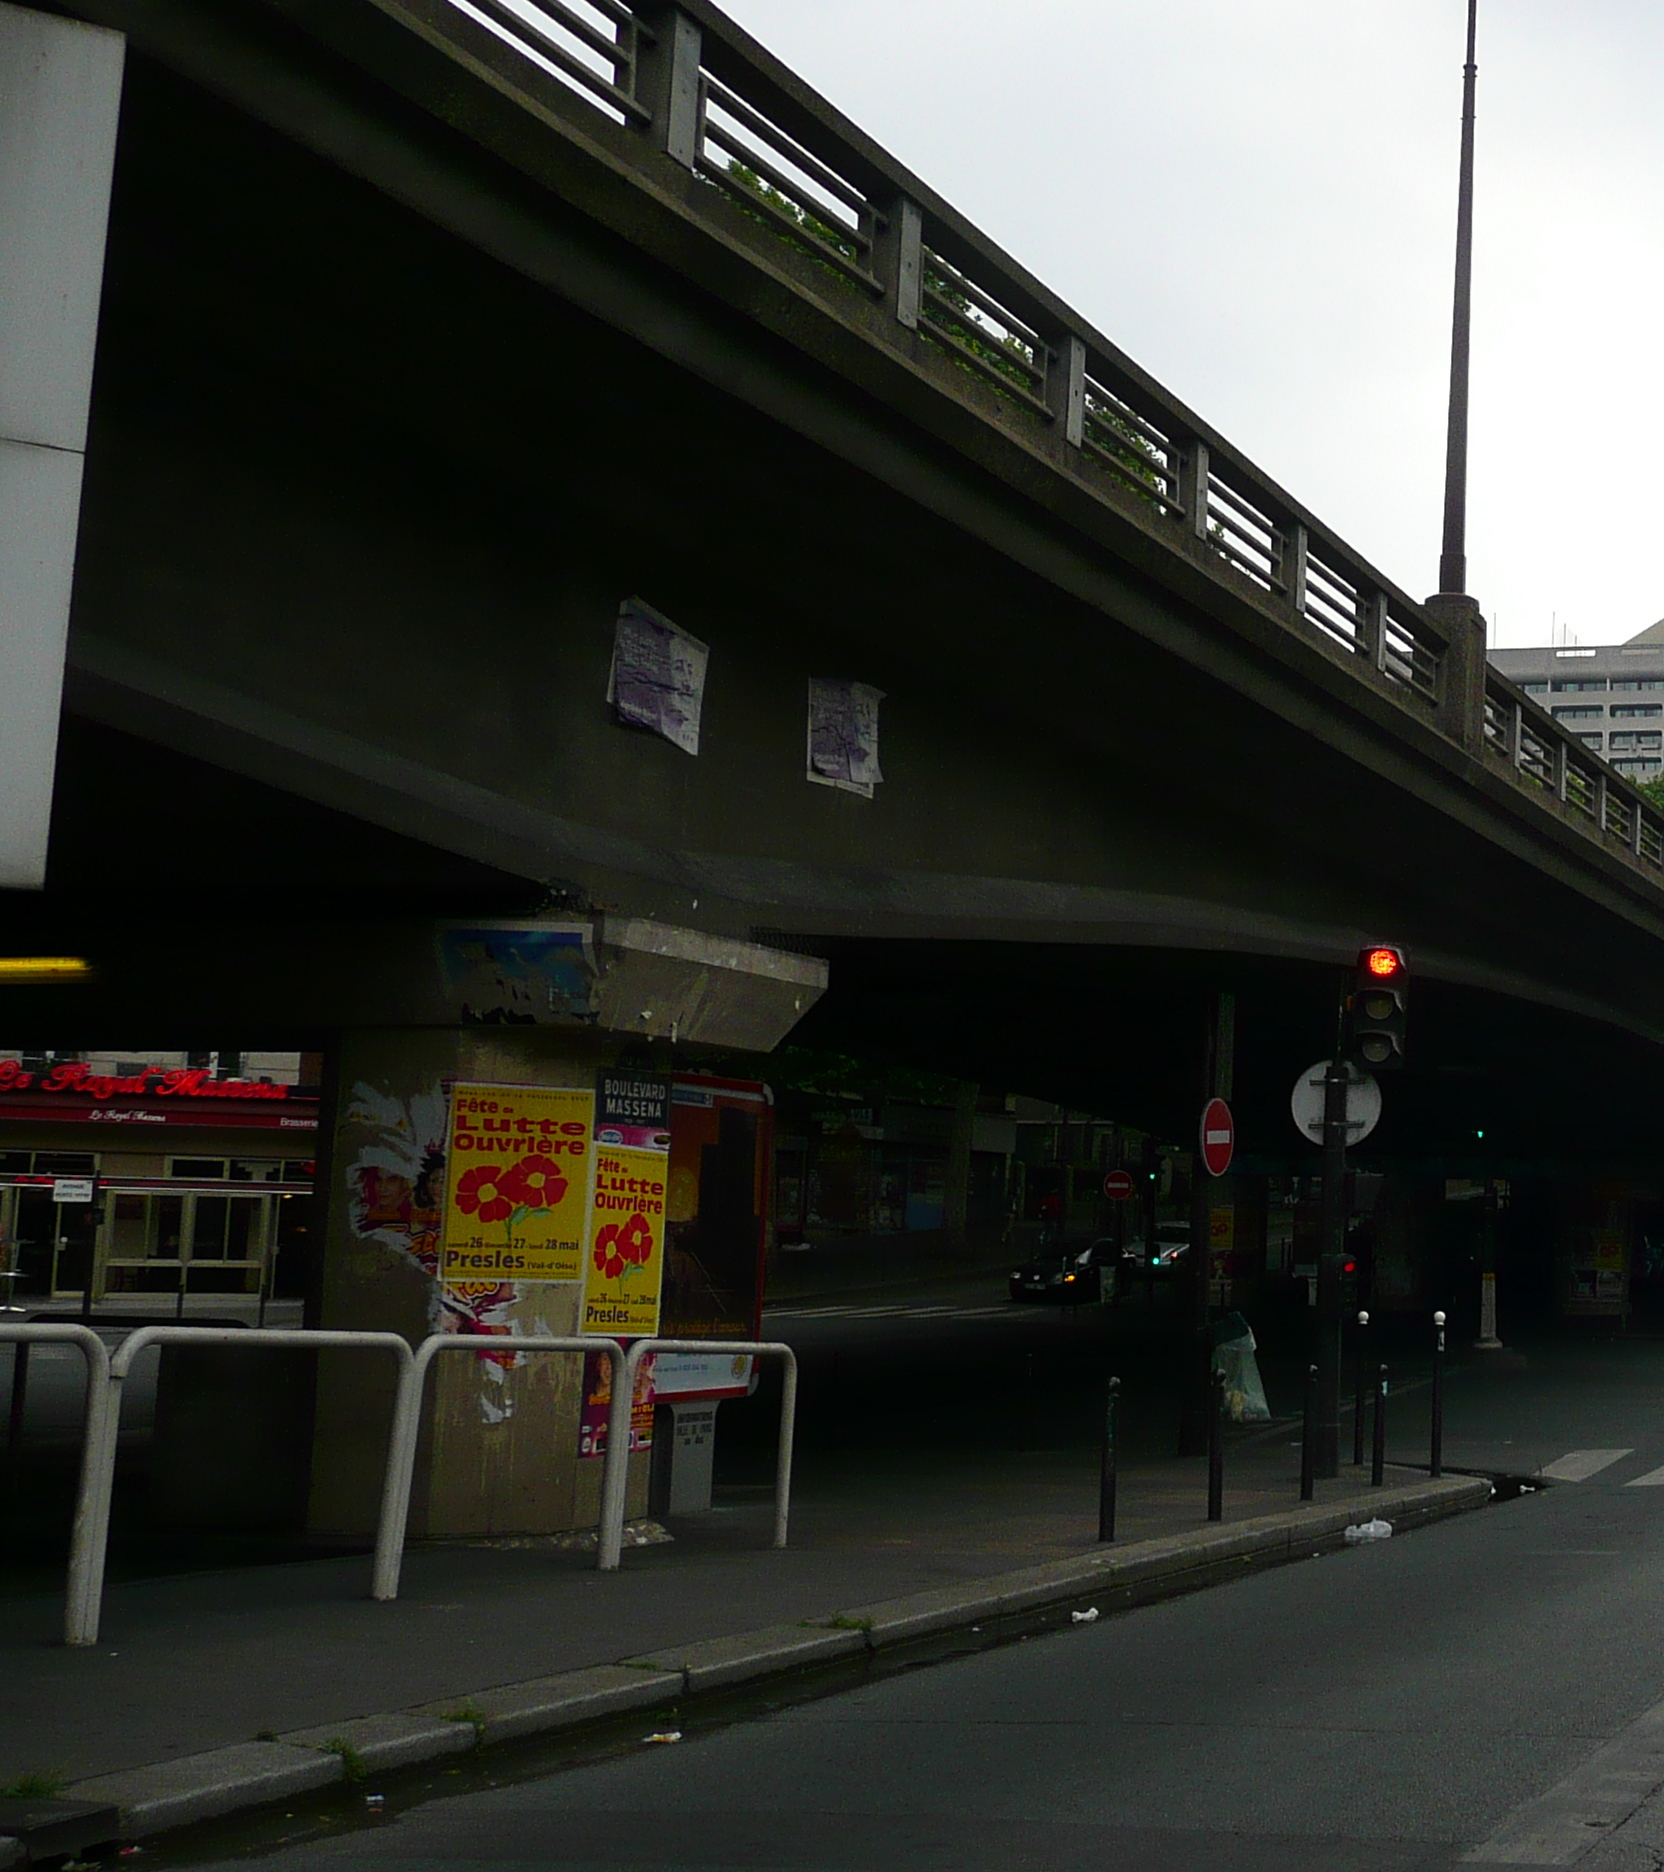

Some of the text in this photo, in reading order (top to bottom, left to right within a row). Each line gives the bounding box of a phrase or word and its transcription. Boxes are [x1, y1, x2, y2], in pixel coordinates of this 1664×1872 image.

[40, 1062, 162, 1100] Royal
[604, 1079, 666, 1100] BOULEVARD
[457, 1098, 498, 1113] Fête
[606, 1098, 662, 1119] MASSENA
[280, 1116, 319, 1128] Brasserie
[456, 1115, 586, 1136] Lutte
[454, 1133, 585, 1155] Ouvrière
[597, 1158, 620, 1173] Fête
[597, 1174, 664, 1195] Lutte
[595, 1193, 663, 1214] Ouvrière
[470, 1236, 483, 1249] 26
[514, 1238, 526, 1249] 27
[545, 1238, 557, 1250] 28
[559, 1240, 579, 1251] mai
[446, 1250, 525, 1268] Presles
[586, 1305, 629, 1323] Presles
